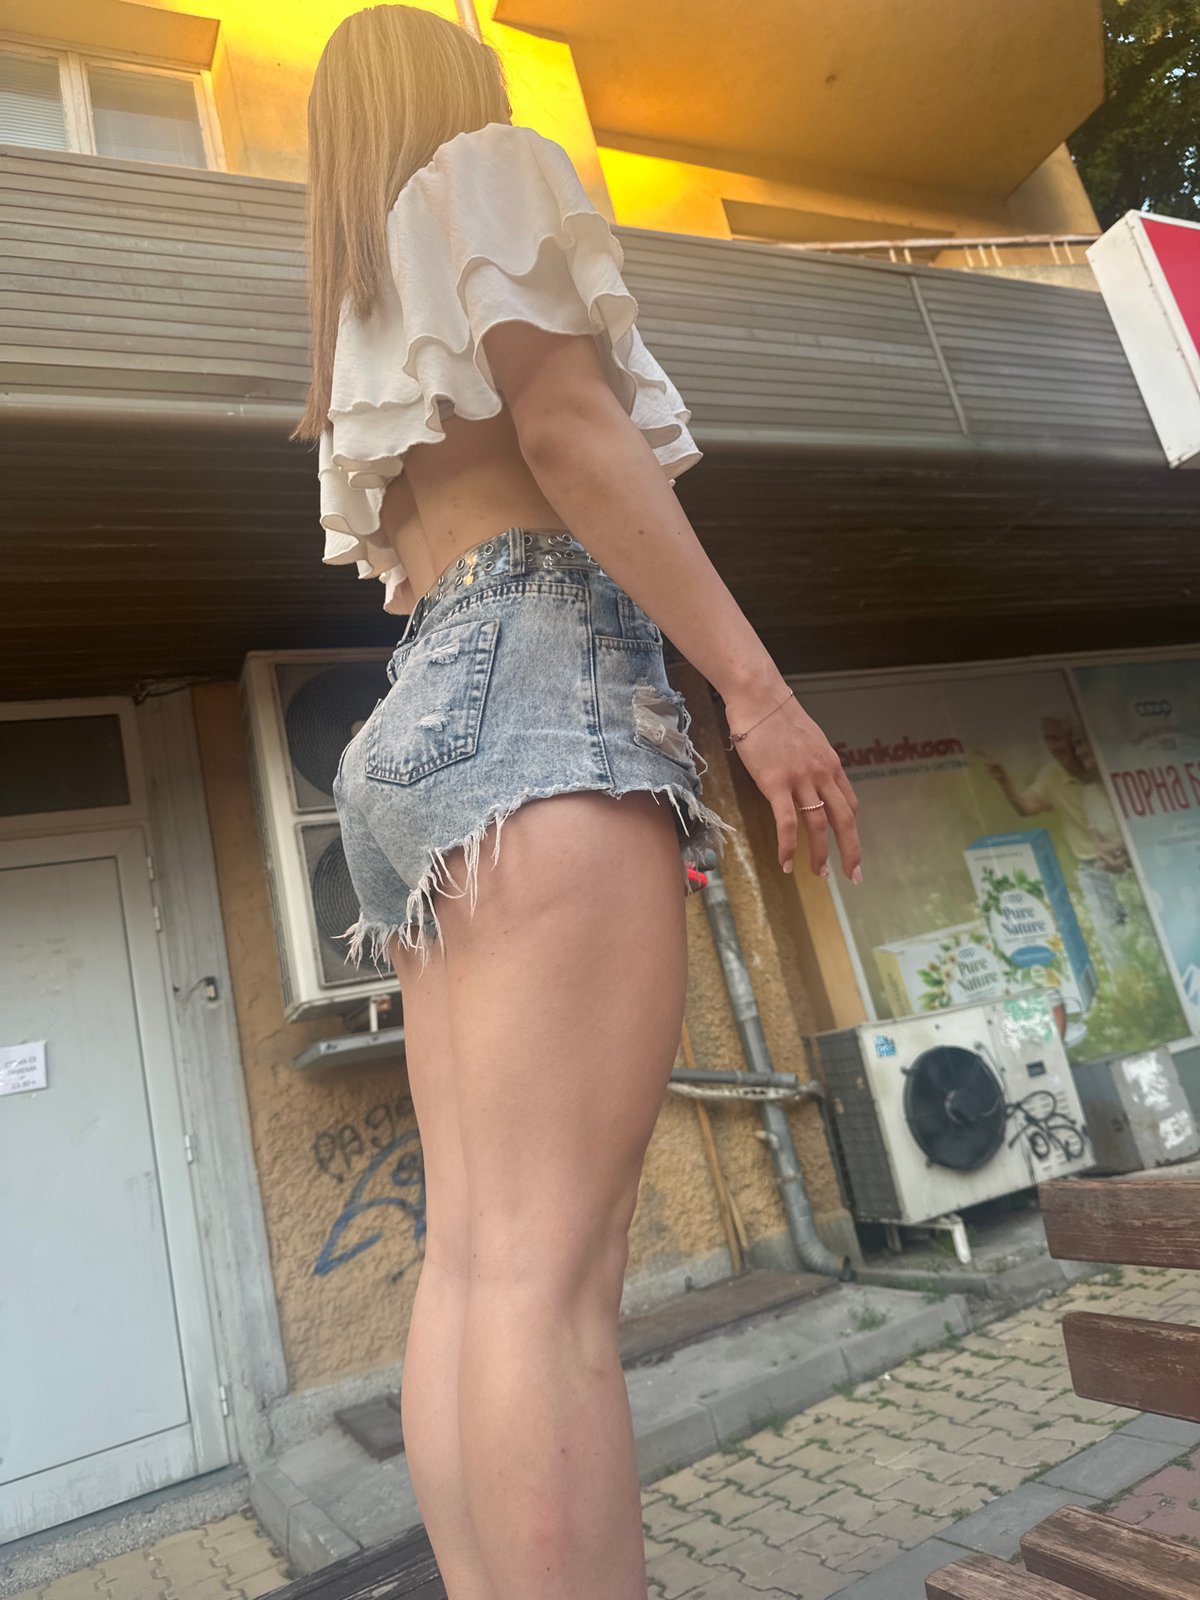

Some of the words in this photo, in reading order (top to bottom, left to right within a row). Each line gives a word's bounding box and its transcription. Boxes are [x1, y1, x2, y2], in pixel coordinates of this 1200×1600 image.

[1002, 906, 1034, 920] Pure
[1001, 921, 1046, 936] Nature
[957, 959, 987, 976] Pure
[957, 972, 997, 991] Nature
